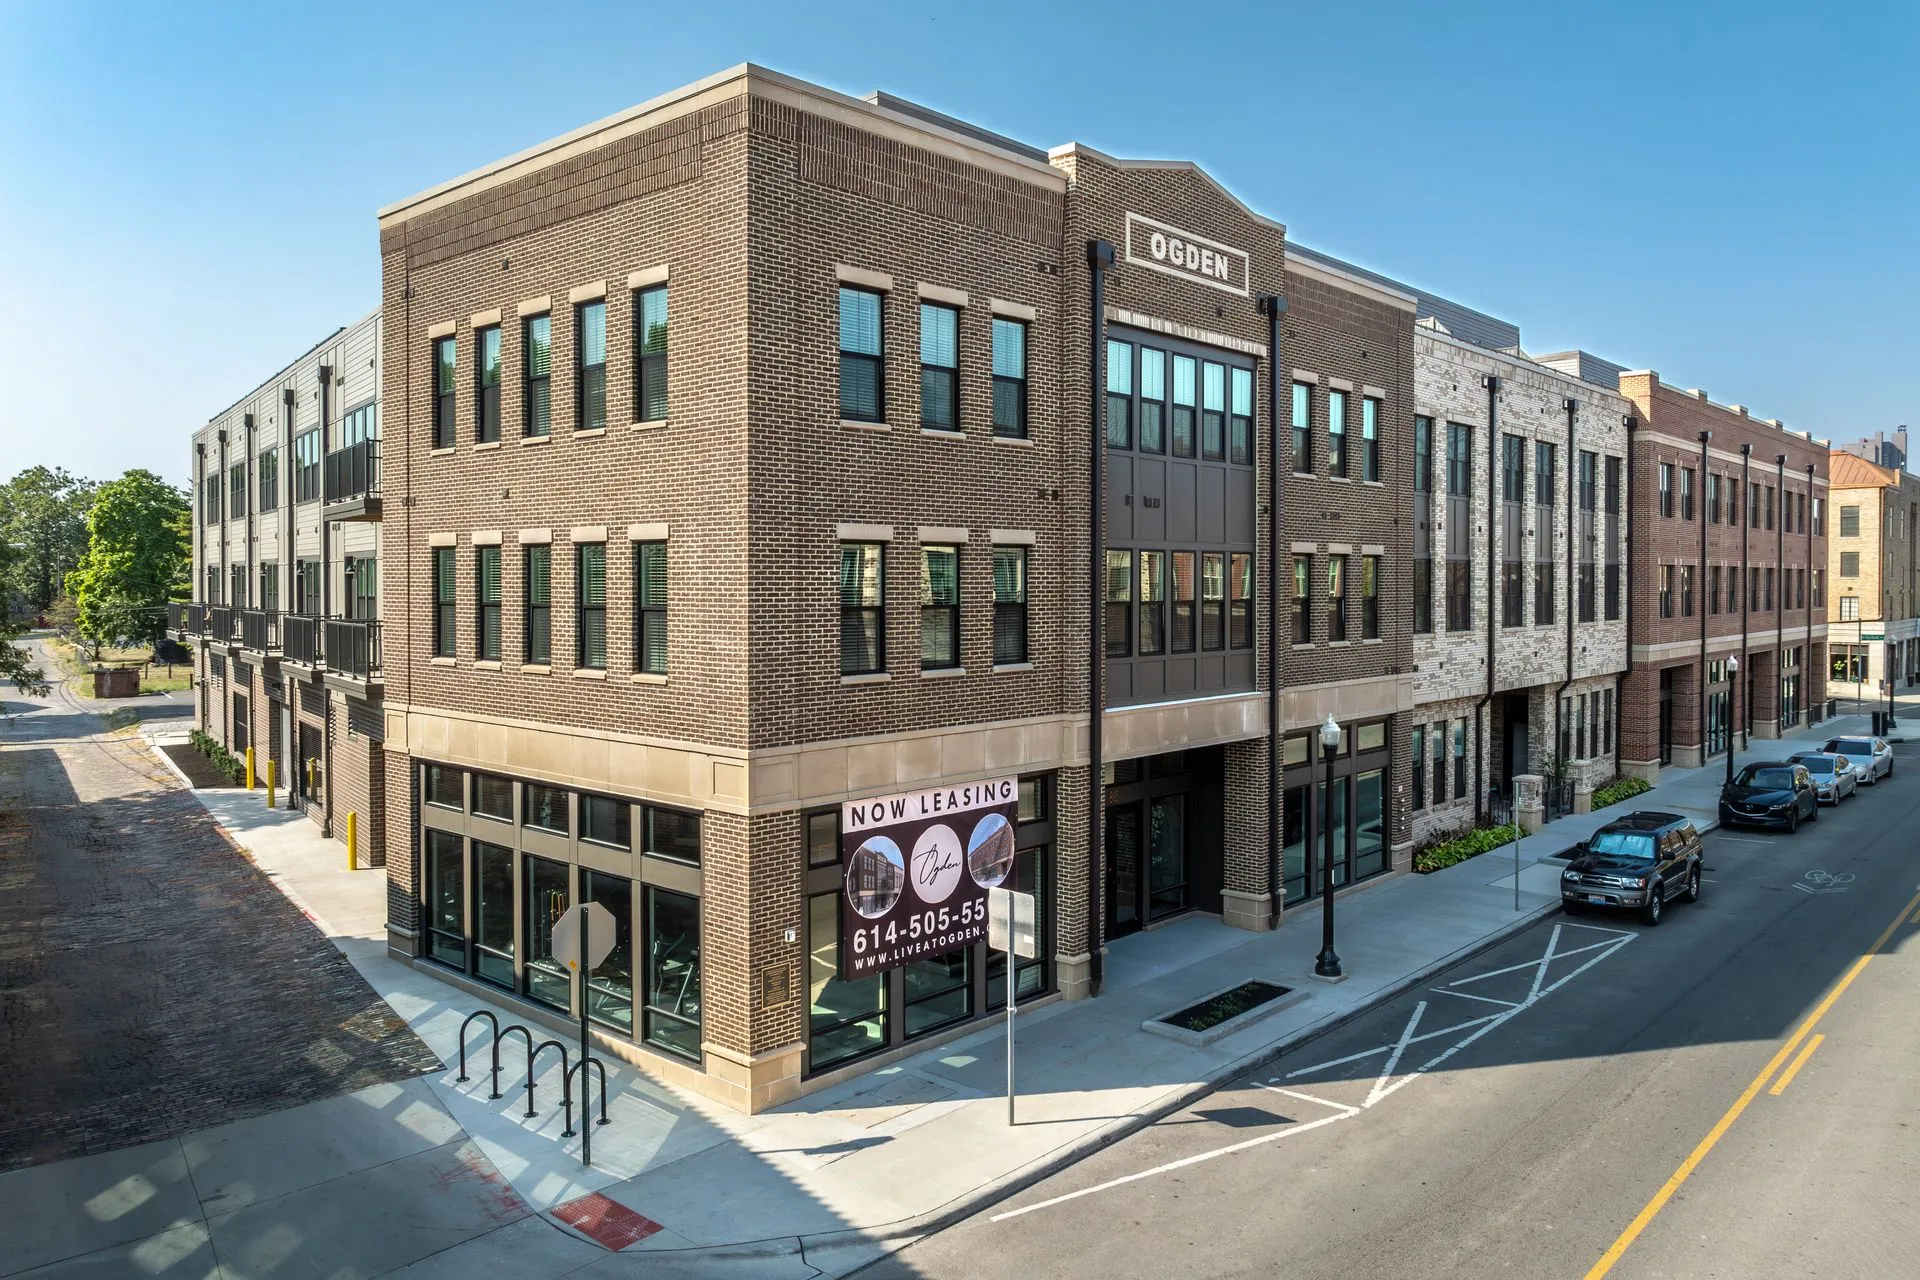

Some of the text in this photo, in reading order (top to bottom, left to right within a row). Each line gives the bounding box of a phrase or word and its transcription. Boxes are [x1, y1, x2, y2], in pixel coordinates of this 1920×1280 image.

[1151, 232, 1228, 280] OGDEN
[851, 781, 1012, 826] NOW LEASING
[913, 843, 961, 885] Ogden
[853, 897, 985, 953] 614-505-55
